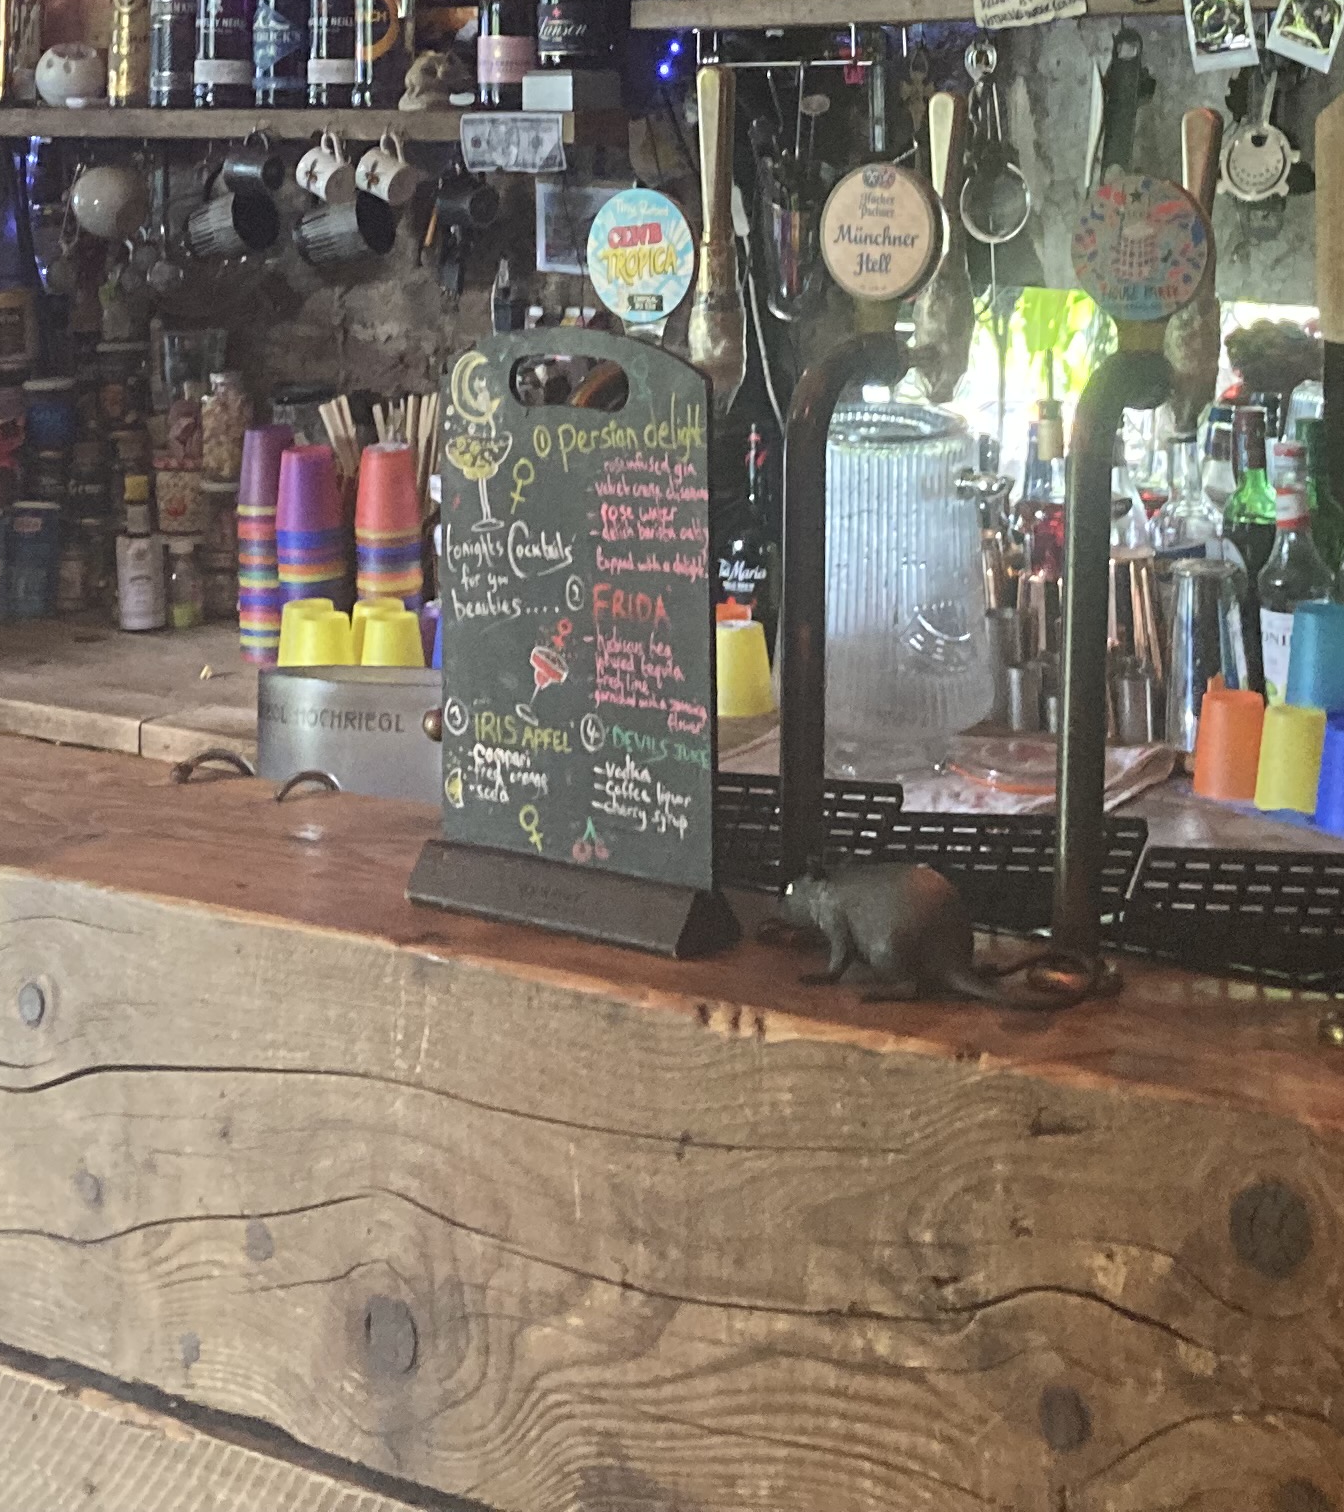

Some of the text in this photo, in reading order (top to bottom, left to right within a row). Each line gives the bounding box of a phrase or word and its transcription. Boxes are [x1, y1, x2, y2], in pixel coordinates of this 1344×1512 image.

[538, 15, 588, 39] Lanson
[833, 223, 920, 249] Münchner
[601, 243, 678, 286] TROPICA
[853, 251, 892, 276] Hell
[727, 560, 768, 582] Maria
[592, 581, 672, 630] FRIDA
[474, 711, 518, 745] IRIS
[521, 725, 573, 754] APFEL
